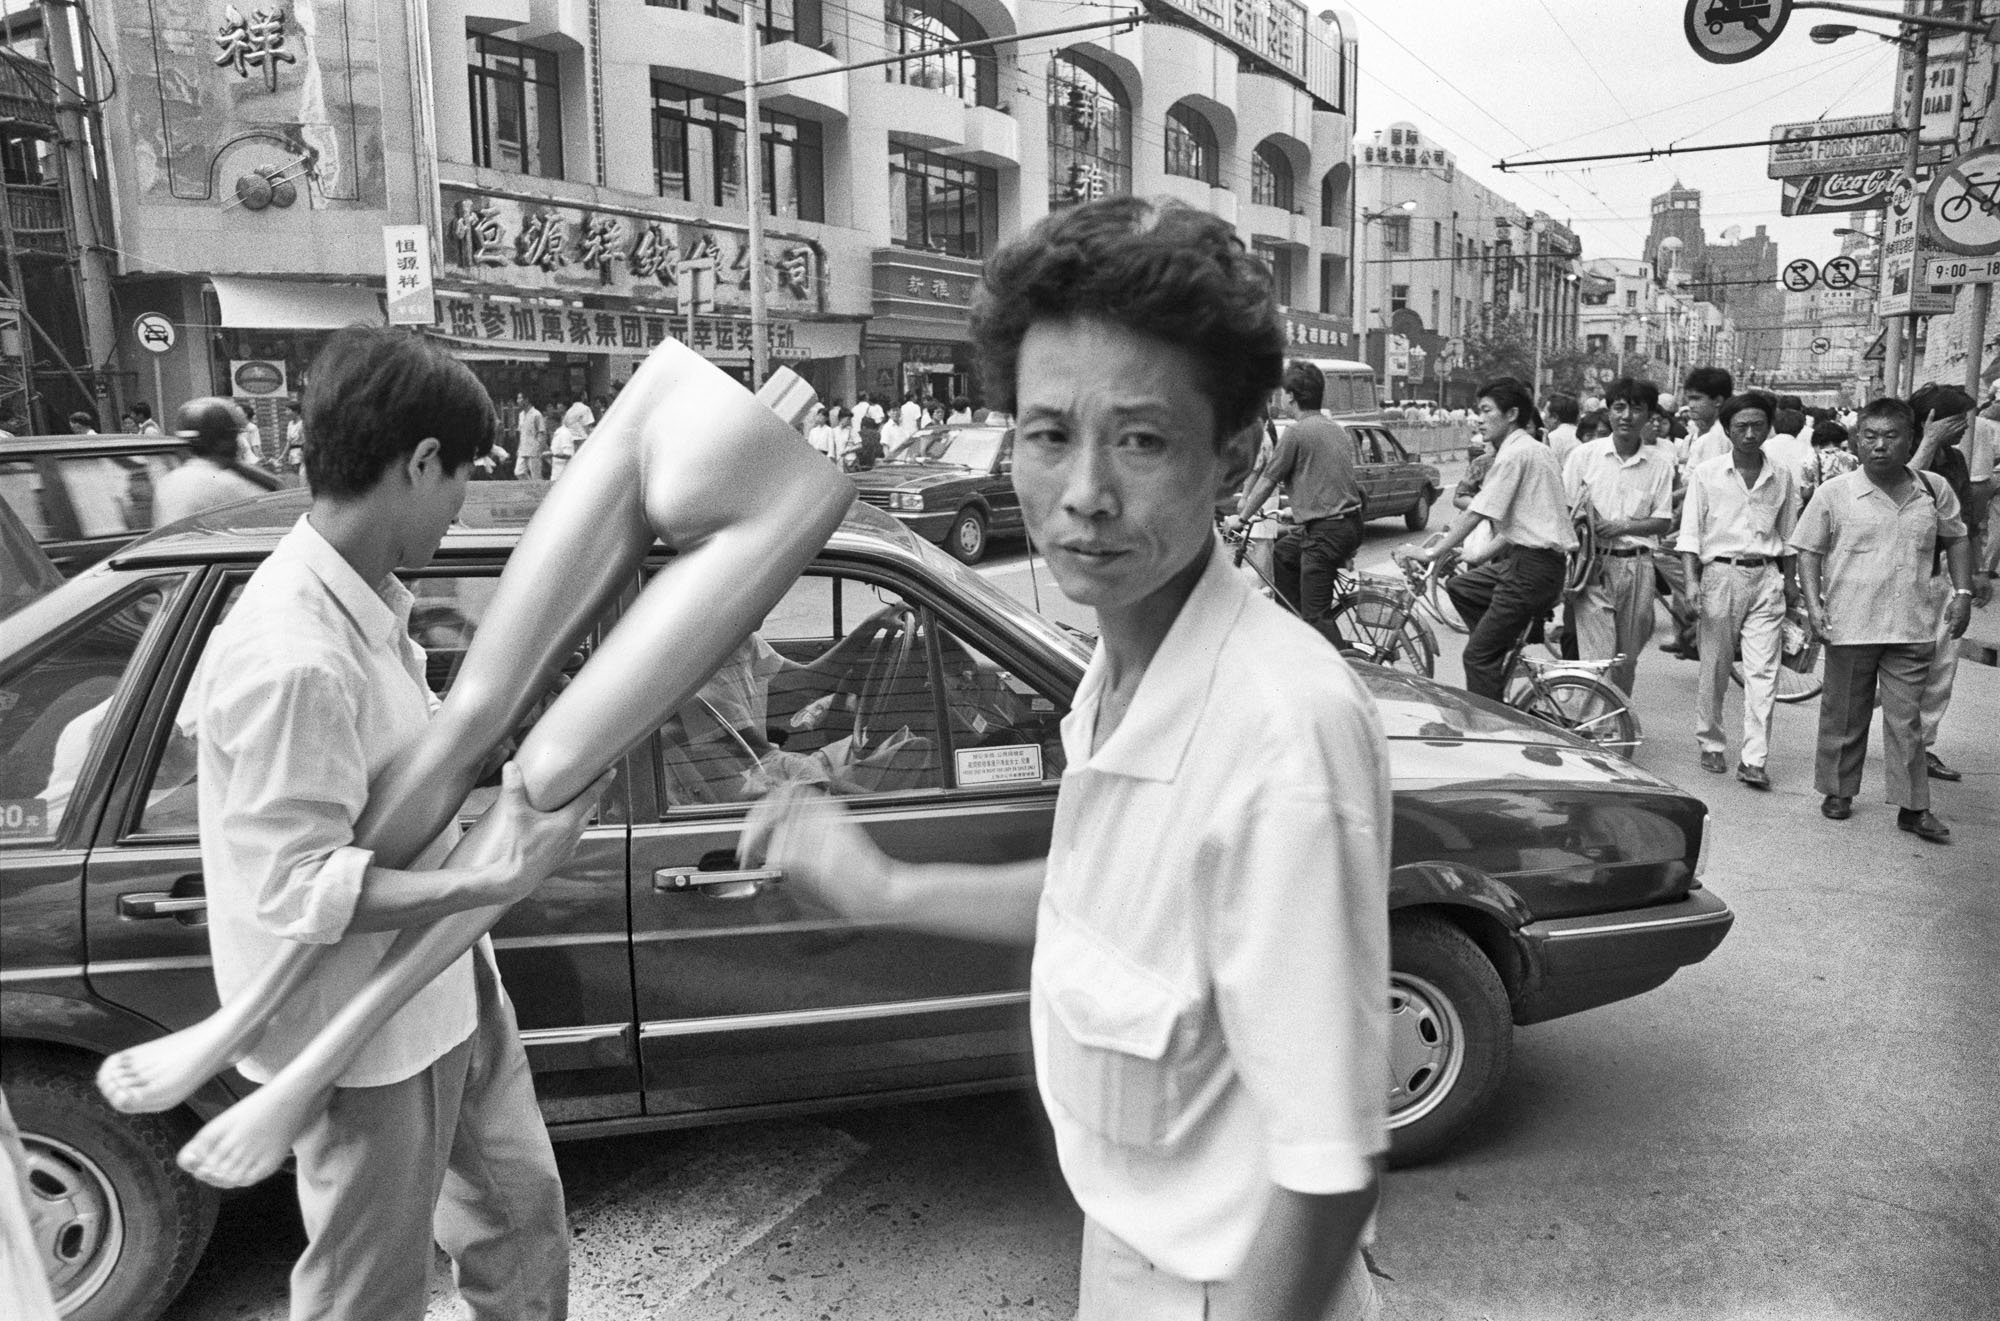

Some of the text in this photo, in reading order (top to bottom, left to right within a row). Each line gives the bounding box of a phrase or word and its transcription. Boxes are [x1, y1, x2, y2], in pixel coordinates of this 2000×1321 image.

[214, 4, 297, 93] 祥
[1818, 138, 1852, 159] FOODS
[1823, 170, 1902, 198] Coca-Col
[396, 239, 420, 289] 恒源祥
[434, 298, 794, 350] 您参加萬象集团萬元幸运奖动
[0, 804, 40, 828] 0元
